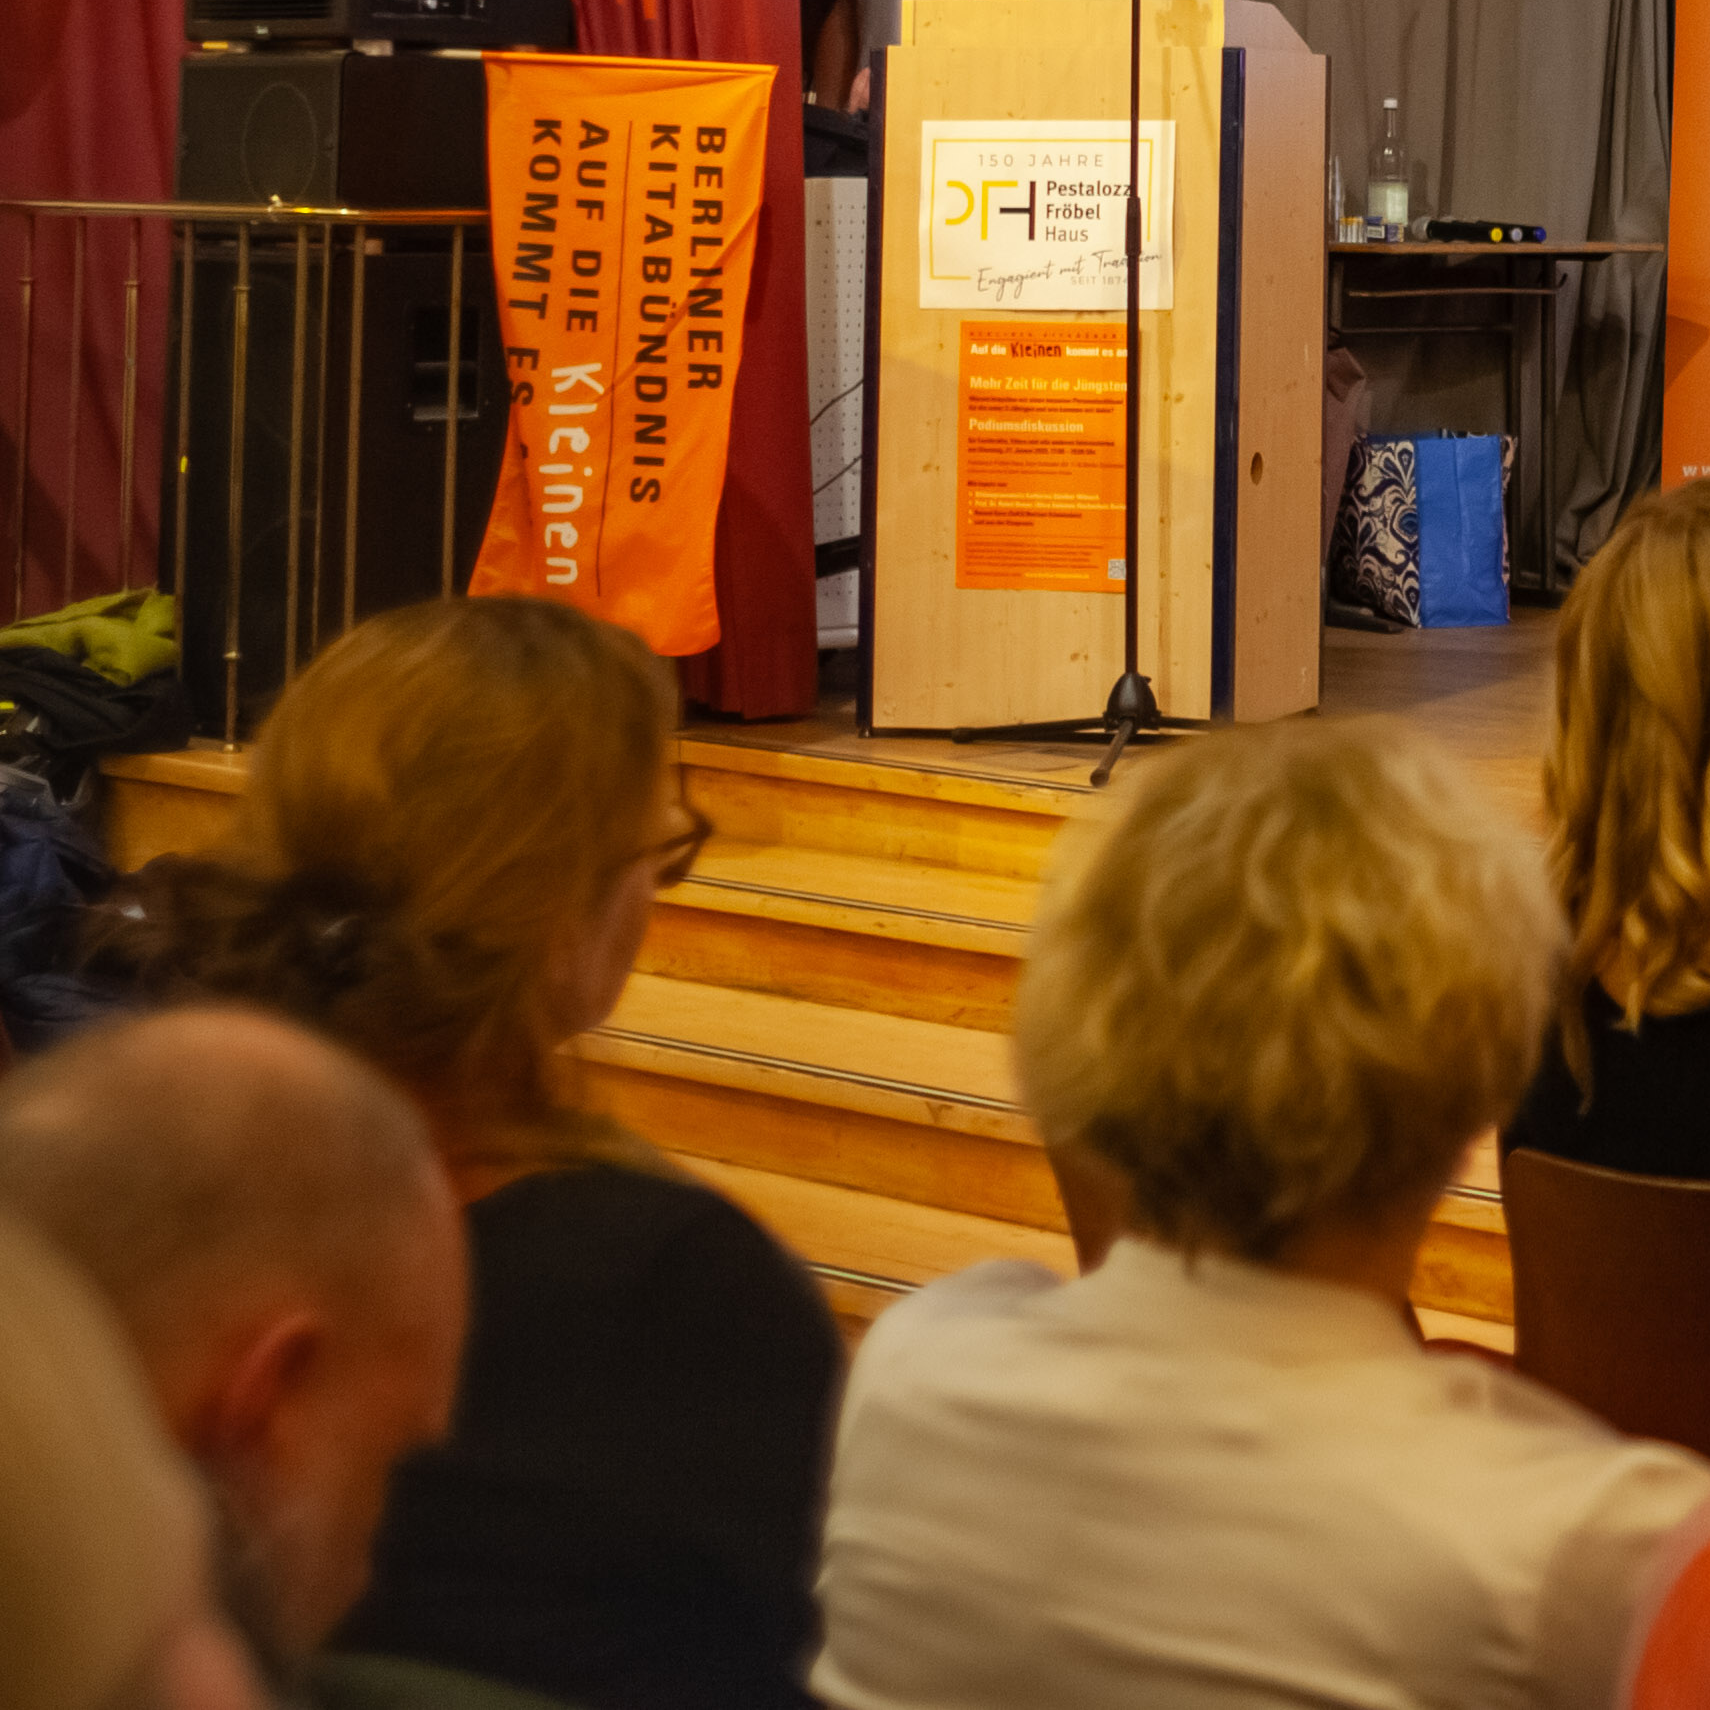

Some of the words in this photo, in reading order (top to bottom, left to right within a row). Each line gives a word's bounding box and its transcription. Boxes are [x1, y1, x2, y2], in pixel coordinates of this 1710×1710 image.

[575, 120, 610, 221] AUF
[978, 154, 1014, 167] 150
[1028, 154, 1104, 167] JAHRE
[1046, 181, 1132, 197] Pestalozz
[508, 118, 562, 320] KOMMT
[1046, 203, 1101, 220] Fröbel
[1045, 226, 1089, 242] Haus
[686, 126, 728, 390] BERLINER
[566, 250, 602, 334] DIE
[629, 124, 681, 504] KITABÜNDNIS
[970, 343, 988, 355] Auf
[991, 344, 1006, 355] die
[1010, 342, 1062, 358] Kleinen
[1066, 346, 1099, 357] kommt
[505, 346, 540, 407] ES
[969, 377, 1001, 390] Mehr
[1005, 377, 1028, 390] Zeit
[1032, 377, 1047, 390] für
[1051, 378, 1070, 391] die
[968, 418, 1084, 433] Podiumsdiskussion
[538, 362, 605, 586] Kleinen
